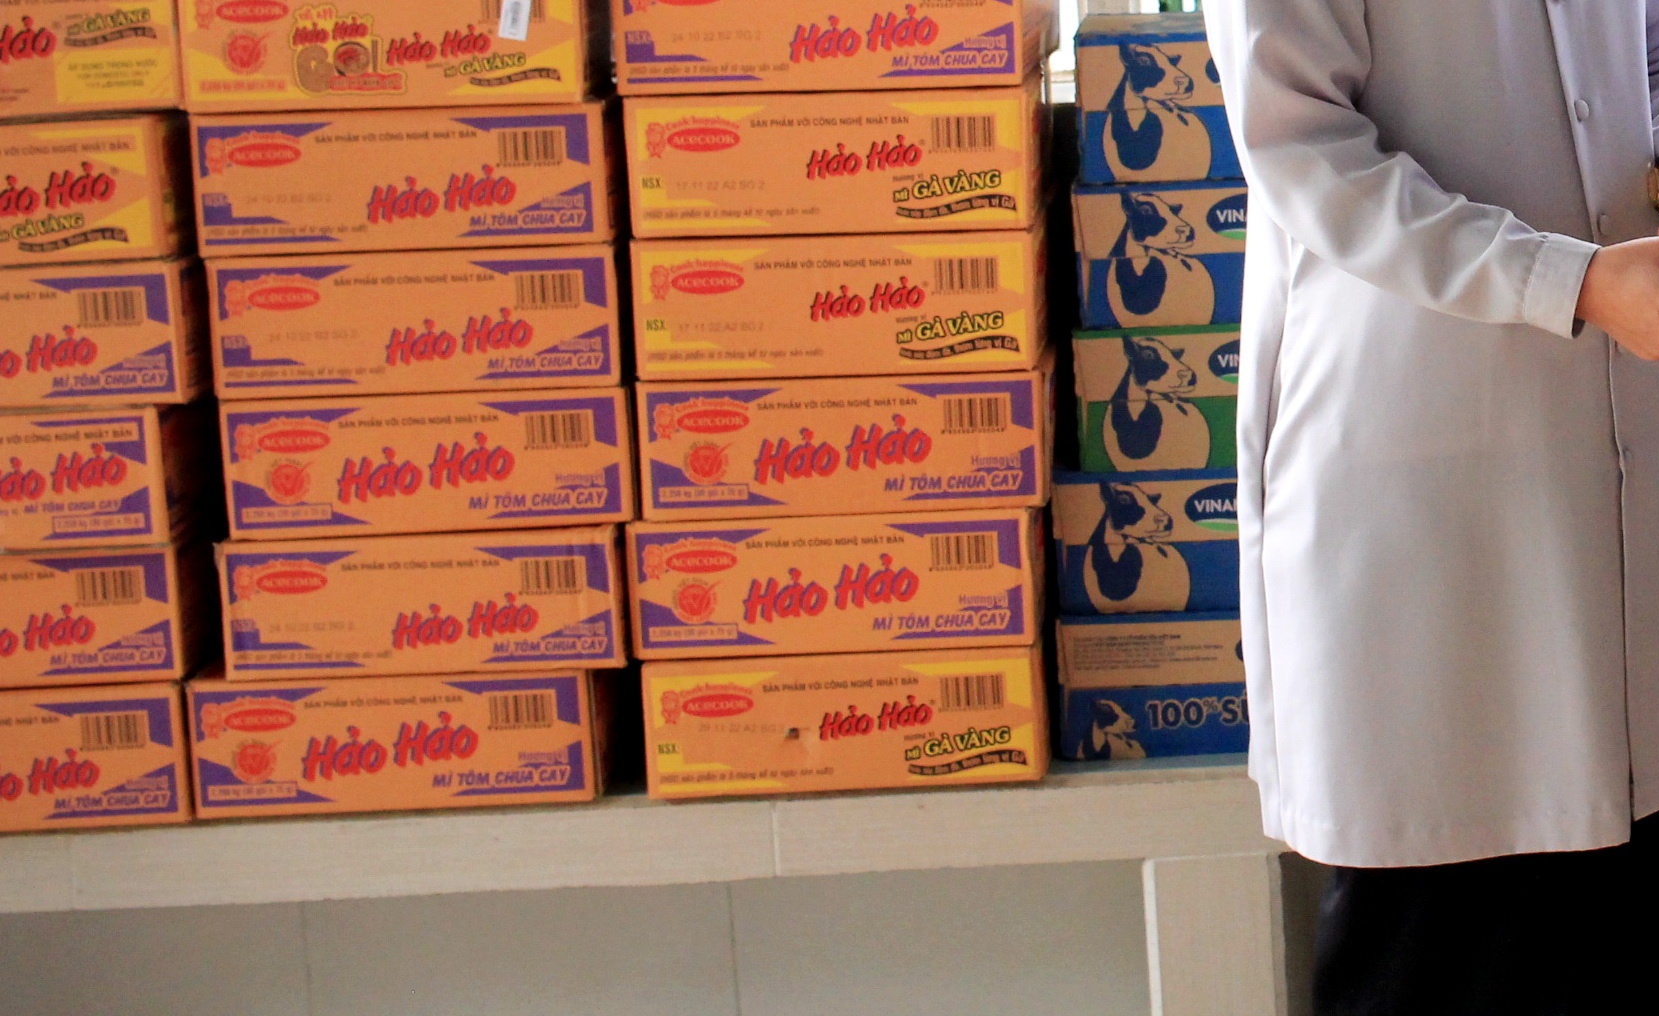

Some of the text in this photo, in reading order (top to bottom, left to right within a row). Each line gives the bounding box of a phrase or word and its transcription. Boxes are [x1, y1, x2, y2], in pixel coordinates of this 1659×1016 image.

[790, 5, 939, 63] Hảo Hảo
[807, 135, 922, 181] Hảo Hảo
[912, 169, 1001, 201] GÀ VÀNG
[810, 277, 926, 322] Hảo Hảo
[915, 311, 1004, 341] GÀ VÀNG
[754, 414, 932, 486] Hảo Hảo
[909, 476, 942, 492] TÔM
[946, 474, 987, 491] CHUA
[989, 471, 1021, 489] CAY
[743, 553, 919, 625] Hảo Hảo
[819, 696, 934, 742] Hảo Hảo
[1147, 698, 1218, 729] 100%
[924, 727, 1011, 756] GÀ VÀNG
